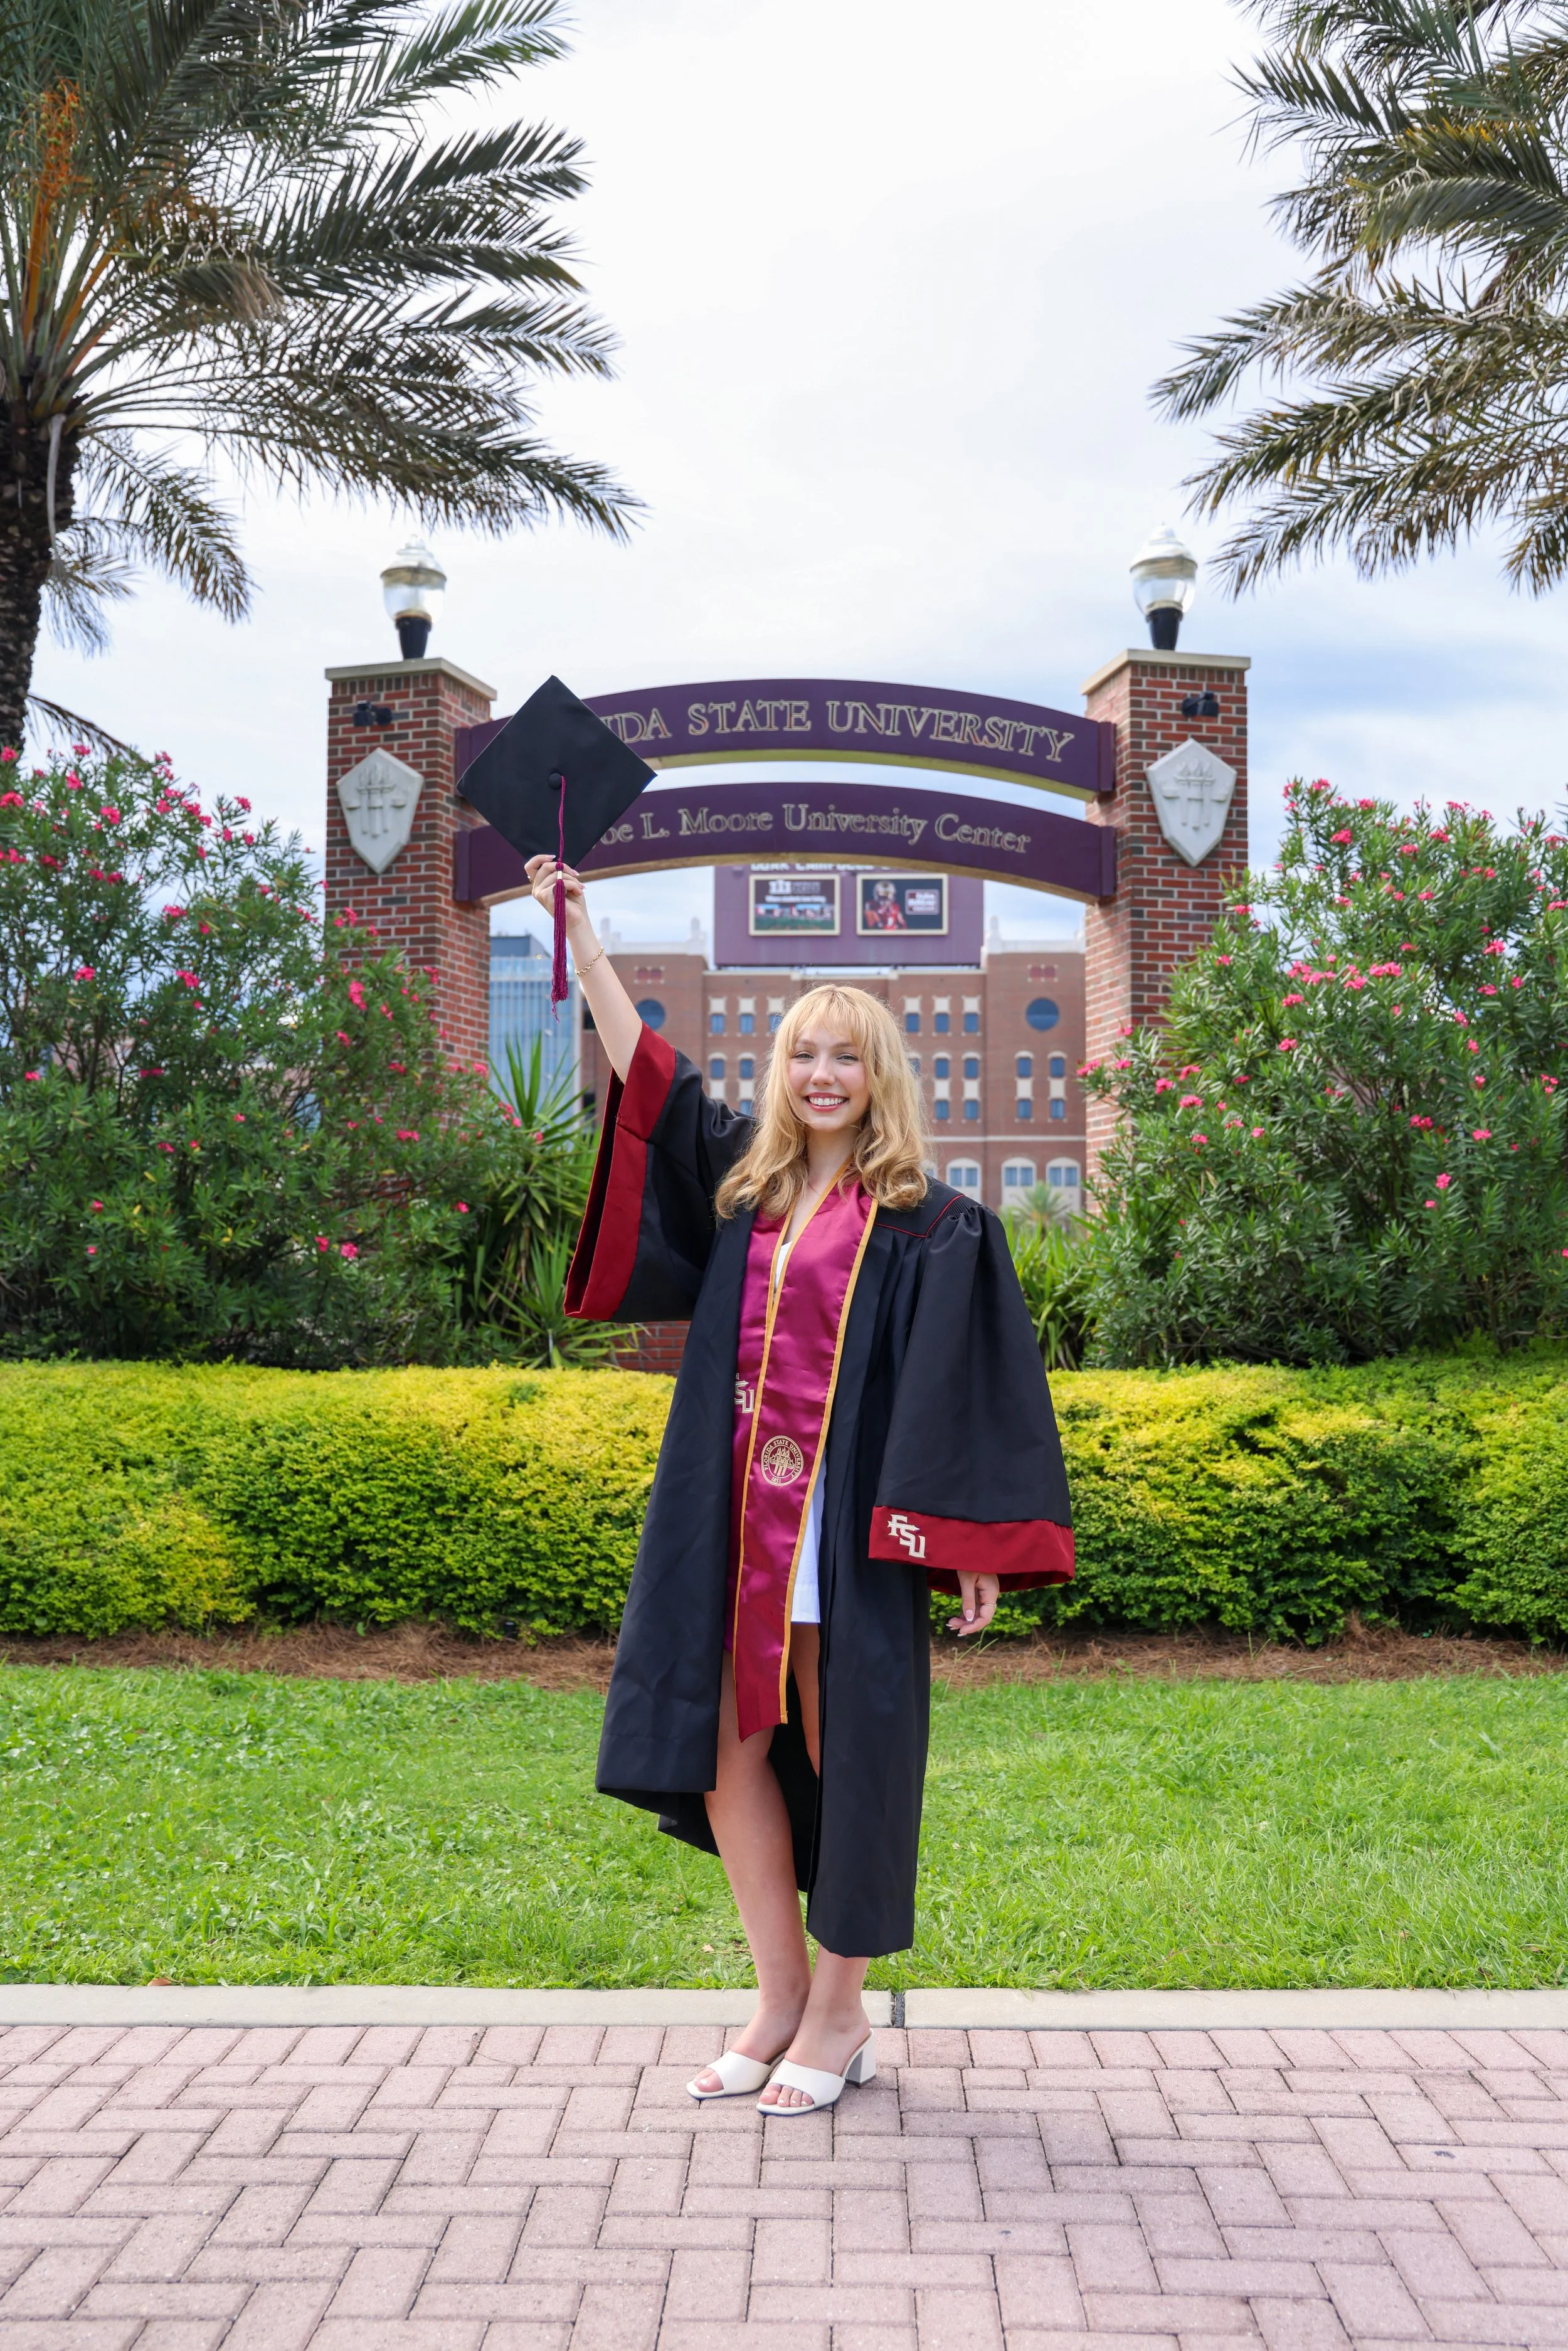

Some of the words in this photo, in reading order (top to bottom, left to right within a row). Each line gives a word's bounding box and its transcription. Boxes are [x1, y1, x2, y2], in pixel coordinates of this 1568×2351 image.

[688, 699, 812, 736] STATE
[826, 701, 1075, 763] UNIVERSITY
[592, 824, 634, 849] oe
[640, 812, 670, 840] L.
[678, 807, 773, 836] Moore
[783, 804, 928, 846] University
[935, 814, 1031, 854] Center
[734, 1373, 755, 1414] SU
[764, 1445, 773, 1470] FLORIDA
[789, 1443, 801, 1478] UNIVERSITY
[887, 1514, 926, 1559] FSU
